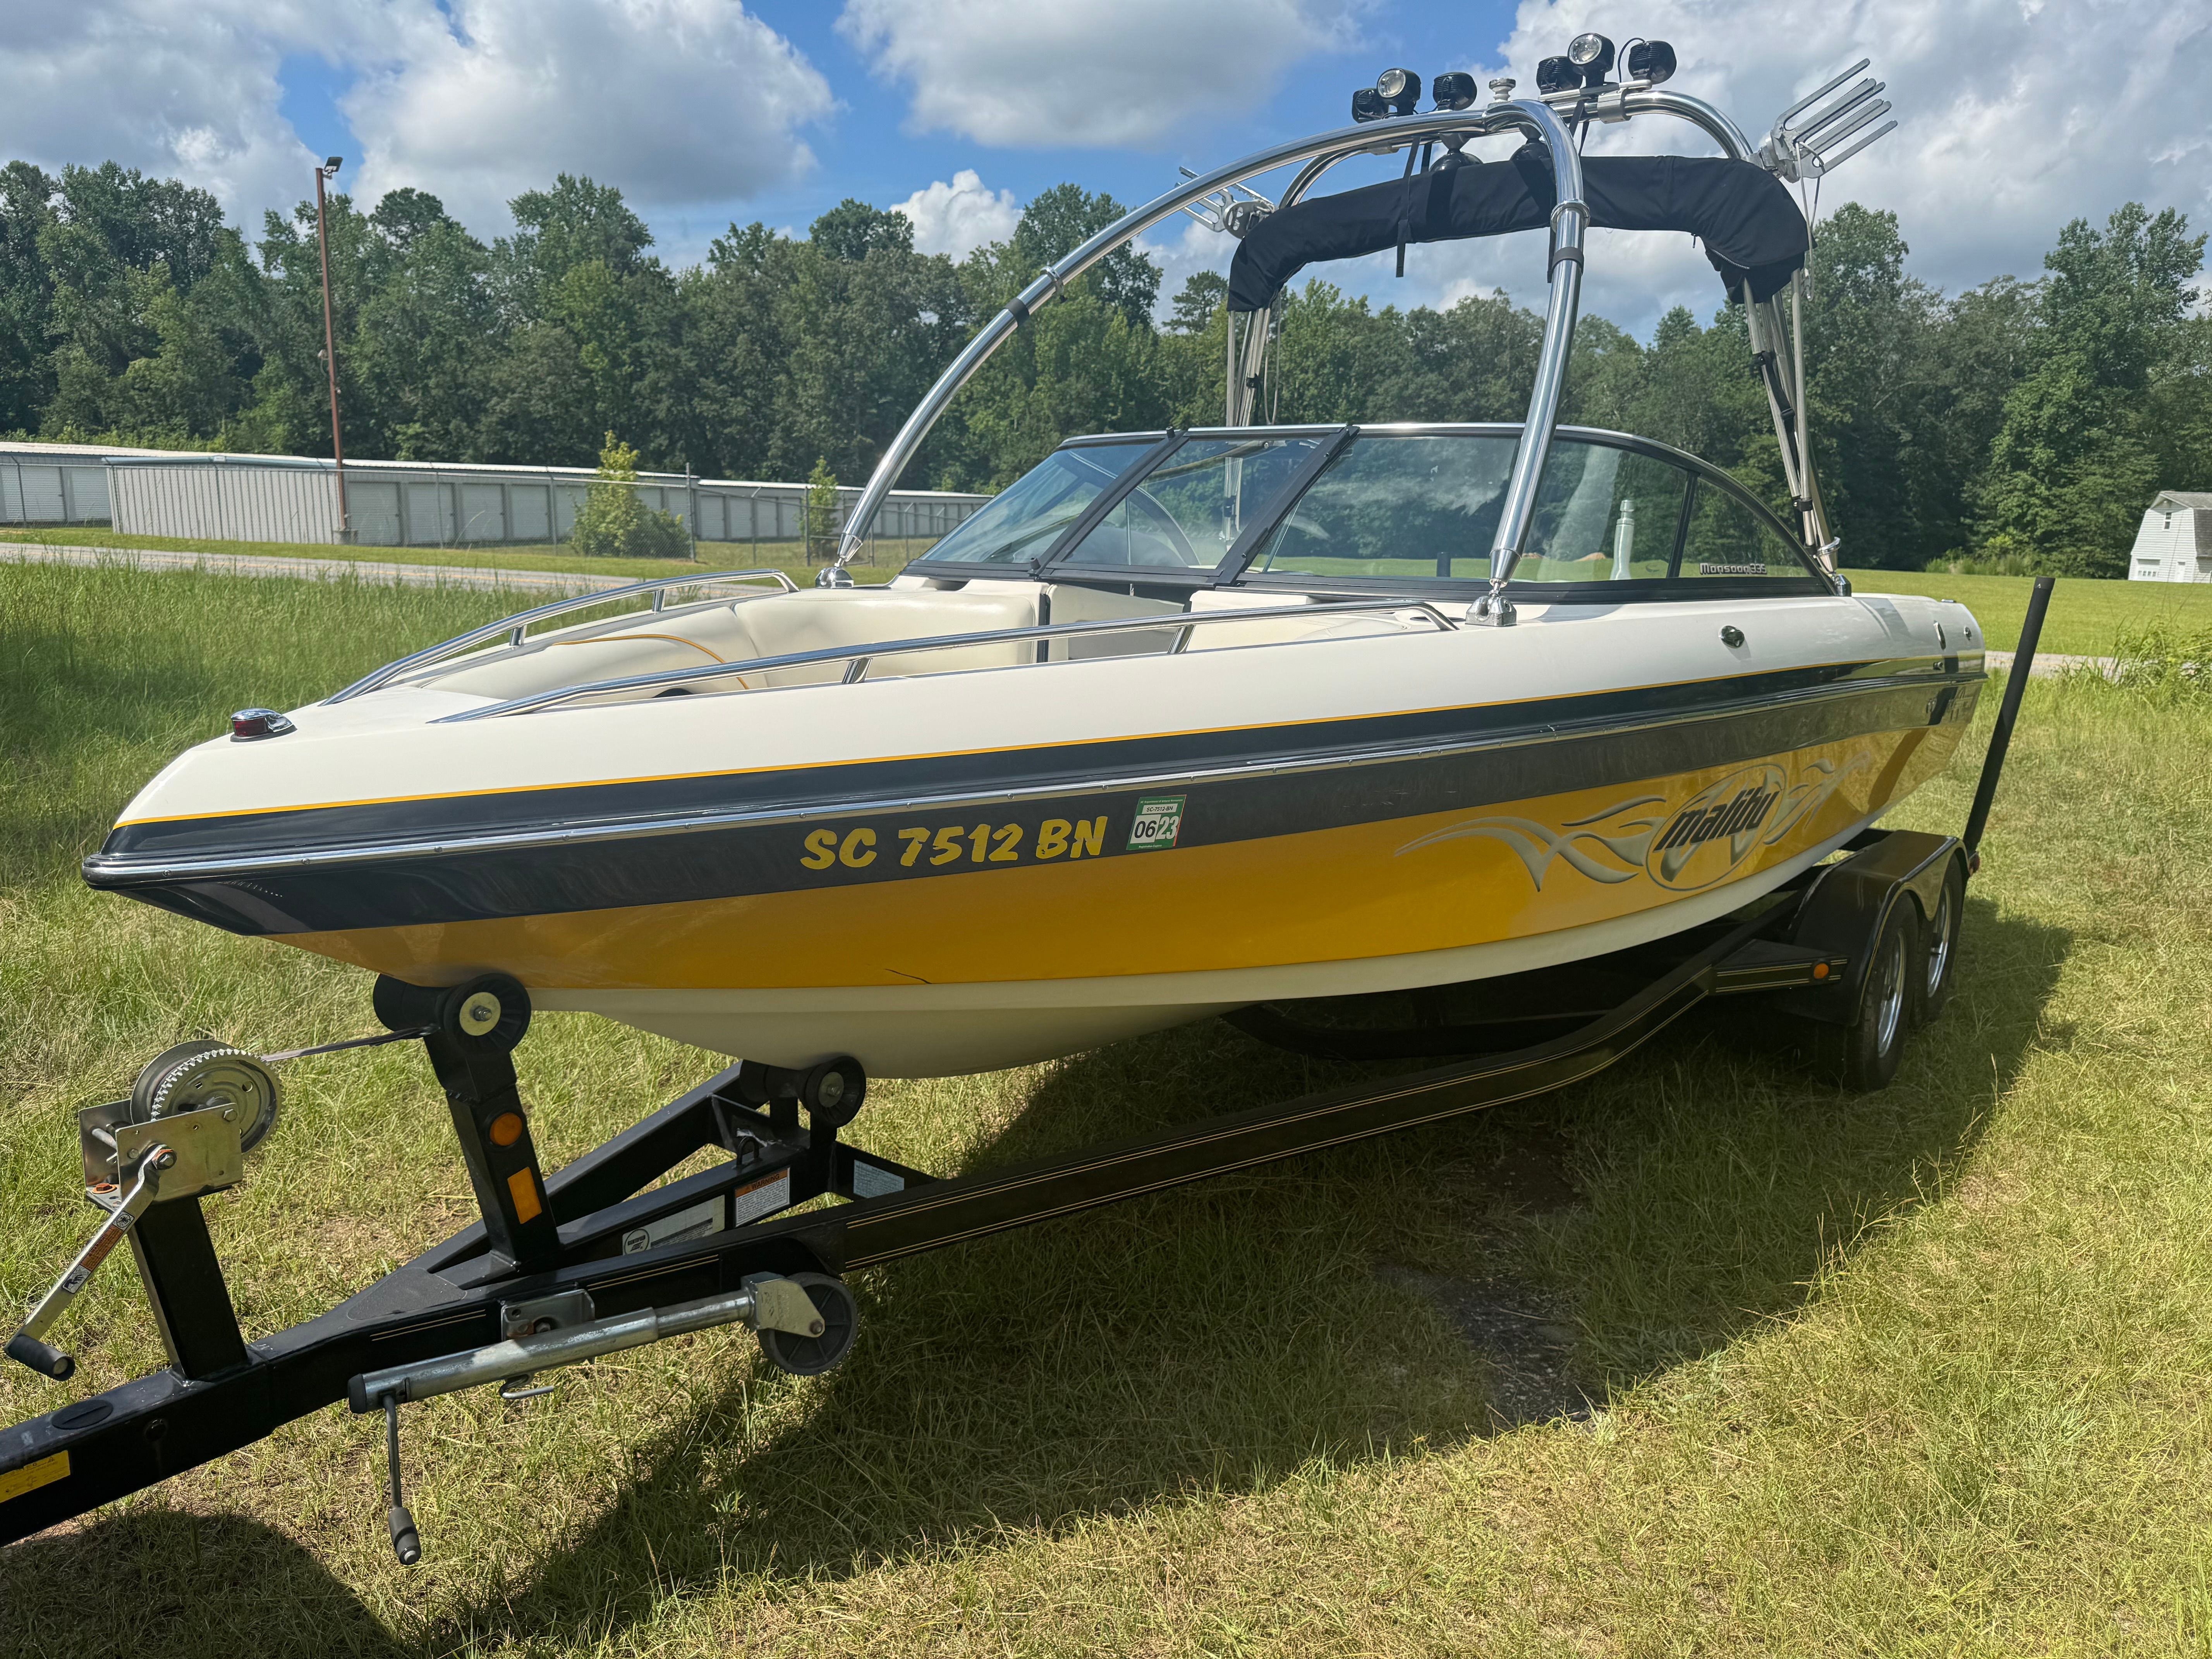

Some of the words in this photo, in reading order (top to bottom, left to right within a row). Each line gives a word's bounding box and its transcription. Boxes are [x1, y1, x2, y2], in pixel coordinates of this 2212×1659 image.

[1134, 820, 1157, 838] 06
[1156, 816, 1179, 840] 23
[1653, 787, 1779, 852] malibu
[800, 828, 877, 869] SC
[898, 823, 1024, 866] 7512
[1036, 816, 1108, 859] BN
[752, 1174, 780, 1189] WARNING
